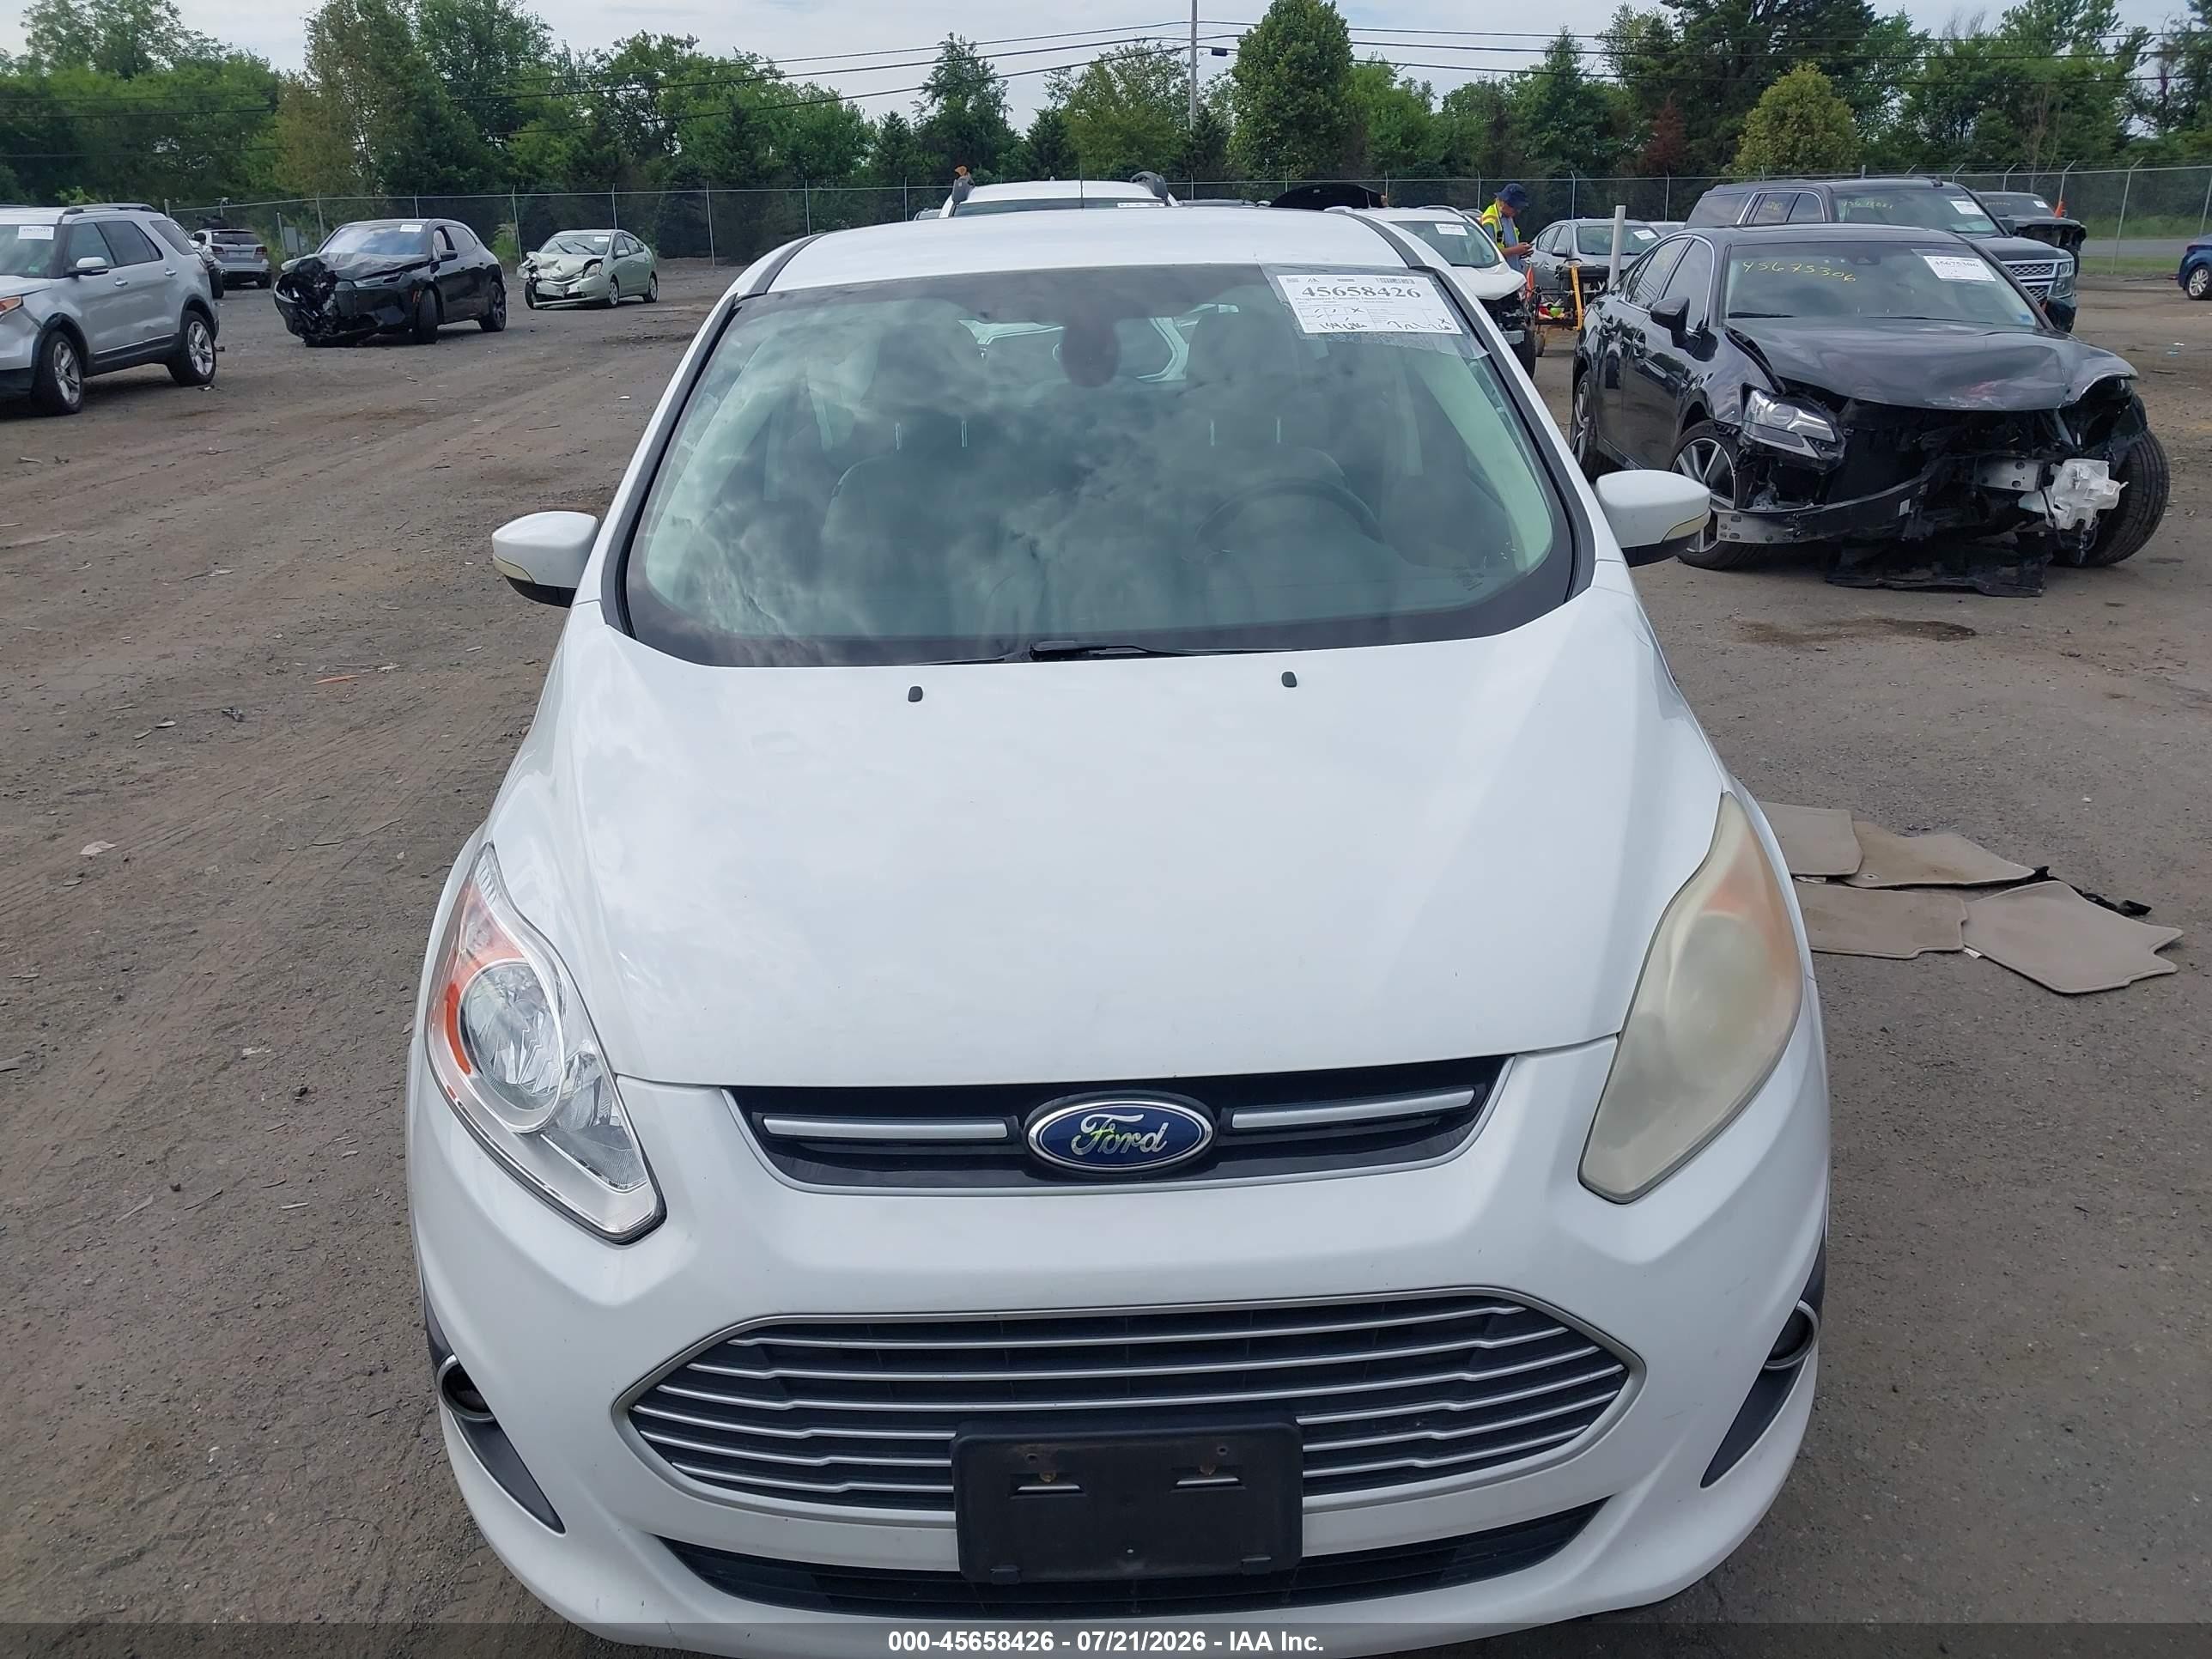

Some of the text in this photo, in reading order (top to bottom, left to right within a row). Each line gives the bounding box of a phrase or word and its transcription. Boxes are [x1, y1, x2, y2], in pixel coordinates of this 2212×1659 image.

[1743, 261, 1856, 282] 45675306
[1302, 286, 1421, 298] 45658426
[1071, 1114, 1170, 1156] Ford
